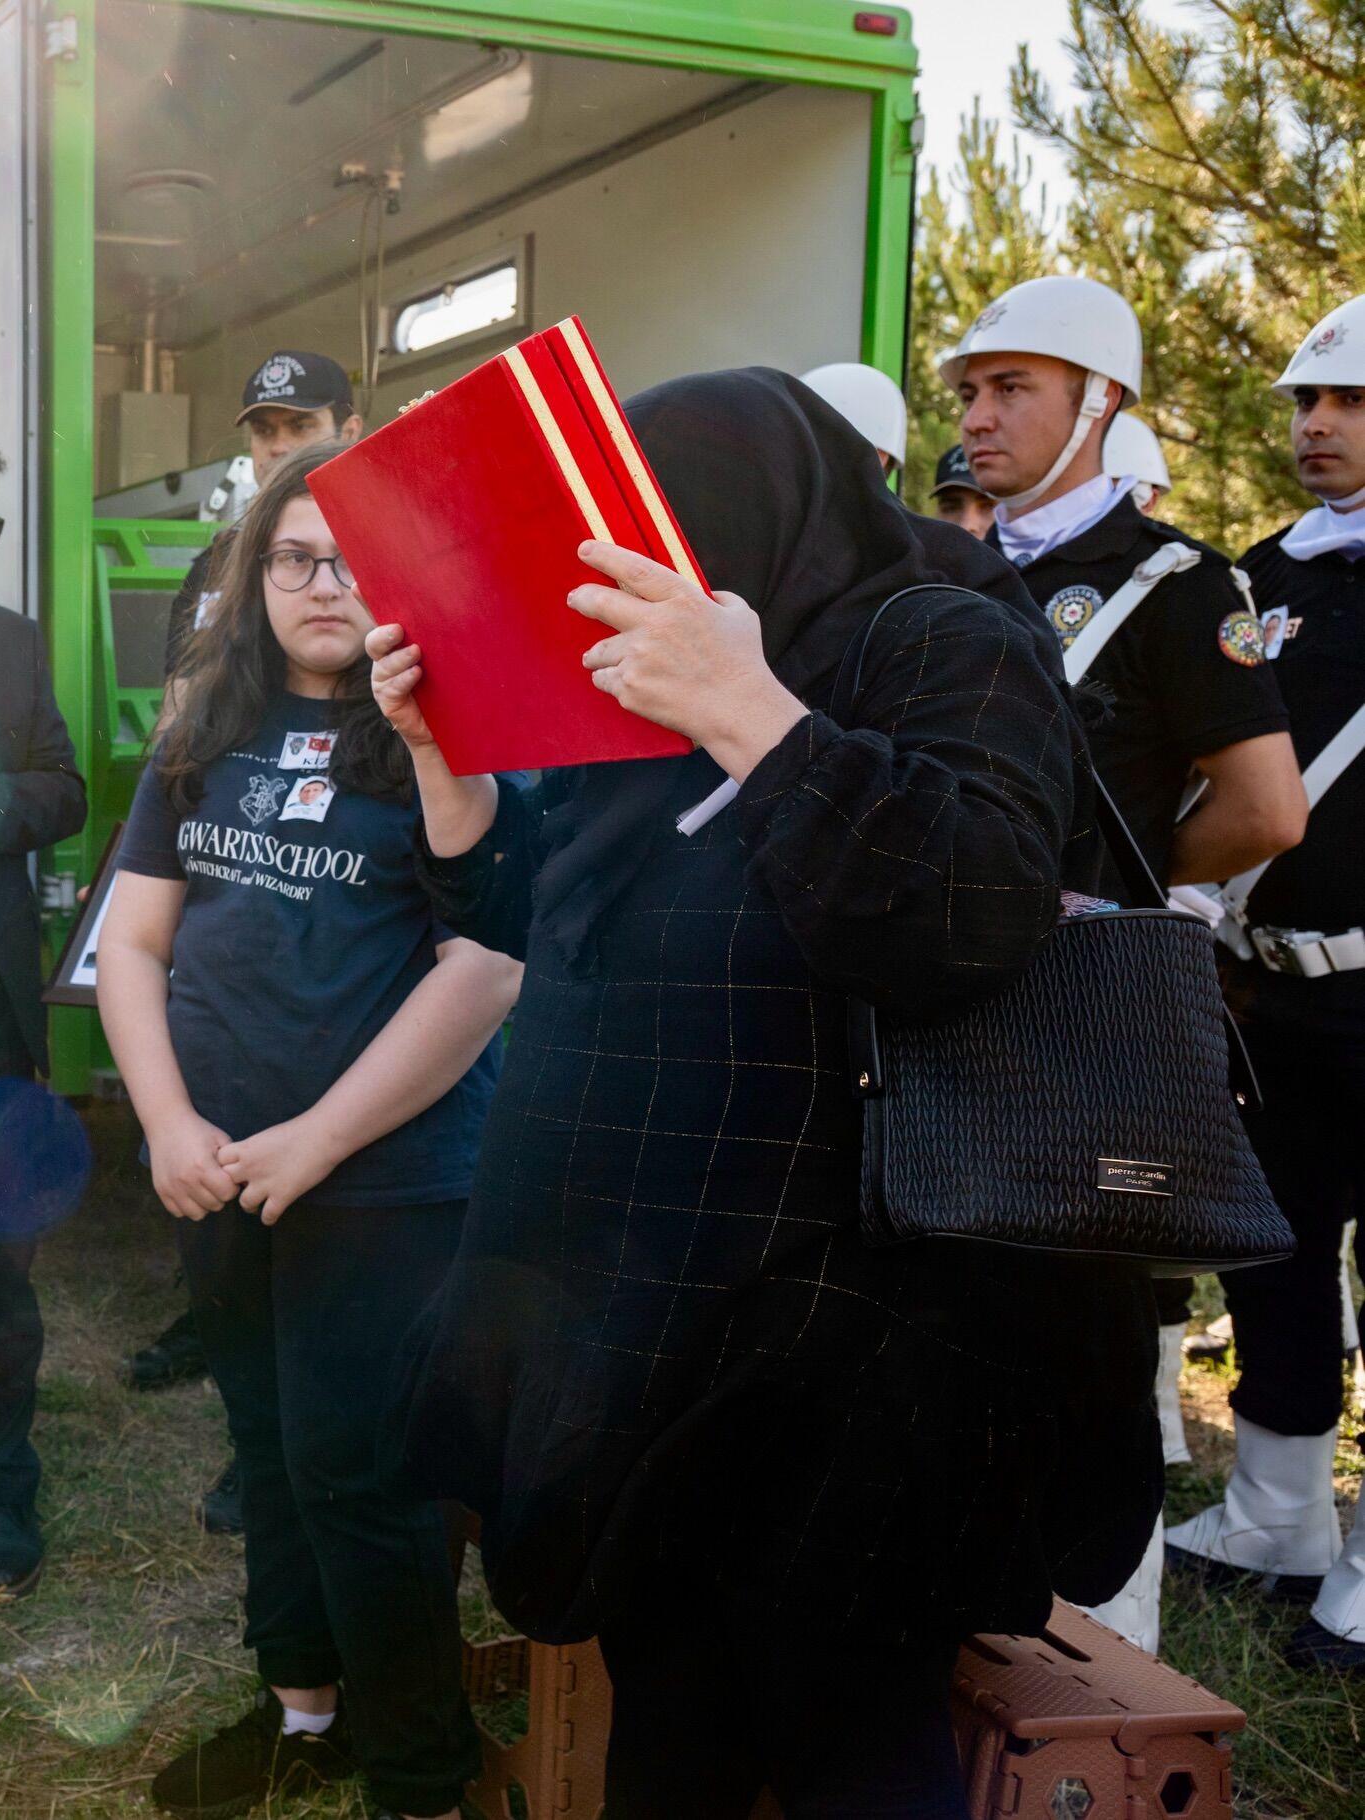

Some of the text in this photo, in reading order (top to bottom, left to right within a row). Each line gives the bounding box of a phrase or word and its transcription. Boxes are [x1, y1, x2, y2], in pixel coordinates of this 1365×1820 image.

[256, 872, 314, 901] WIZARDRY
[1107, 1166, 1166, 1181] pierre cardin
